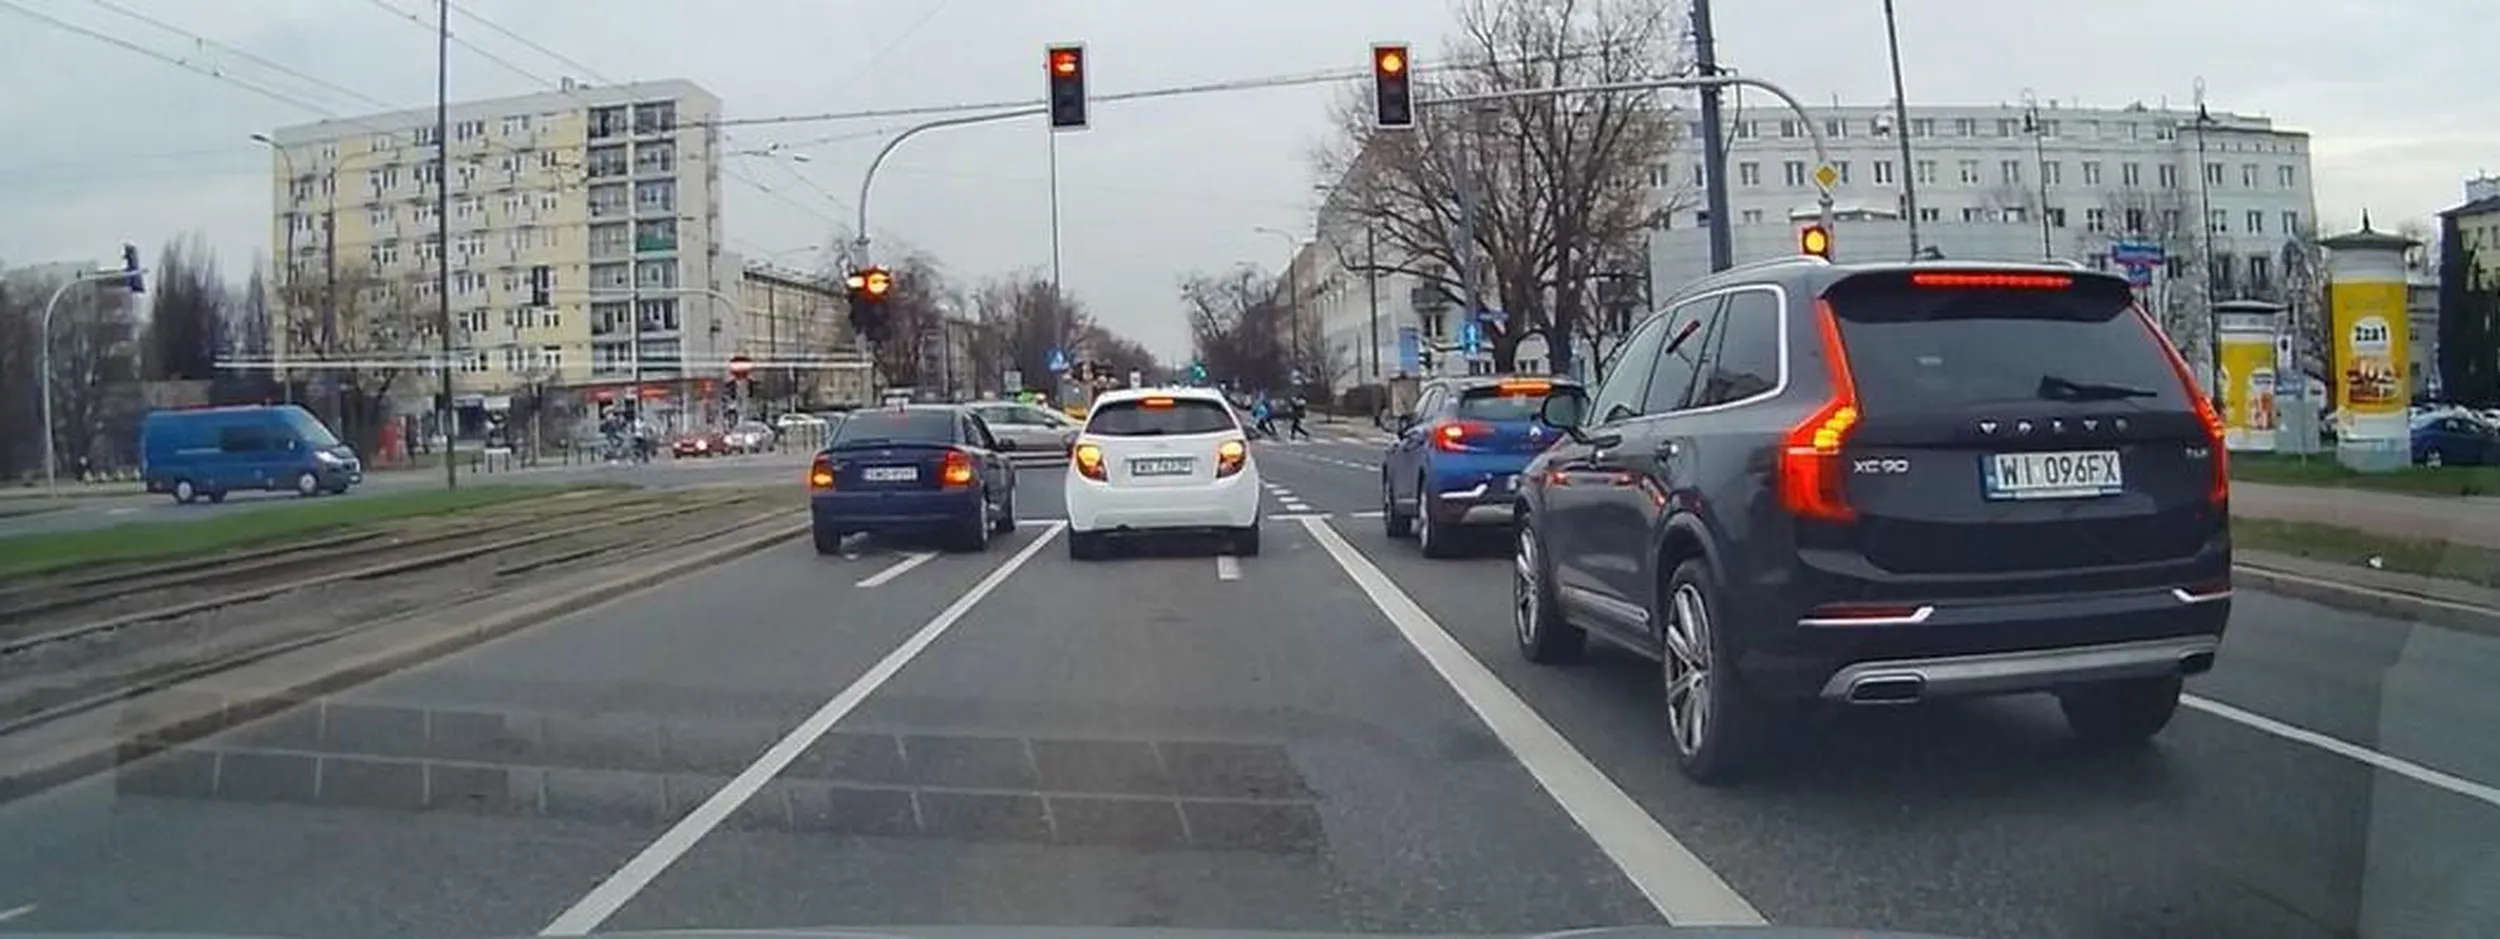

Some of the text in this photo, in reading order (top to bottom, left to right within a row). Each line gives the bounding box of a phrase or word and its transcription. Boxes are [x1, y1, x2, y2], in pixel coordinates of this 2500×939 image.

[1979, 418, 2129, 435] VOLVO
[2000, 454, 2119, 486] WI 096FX
